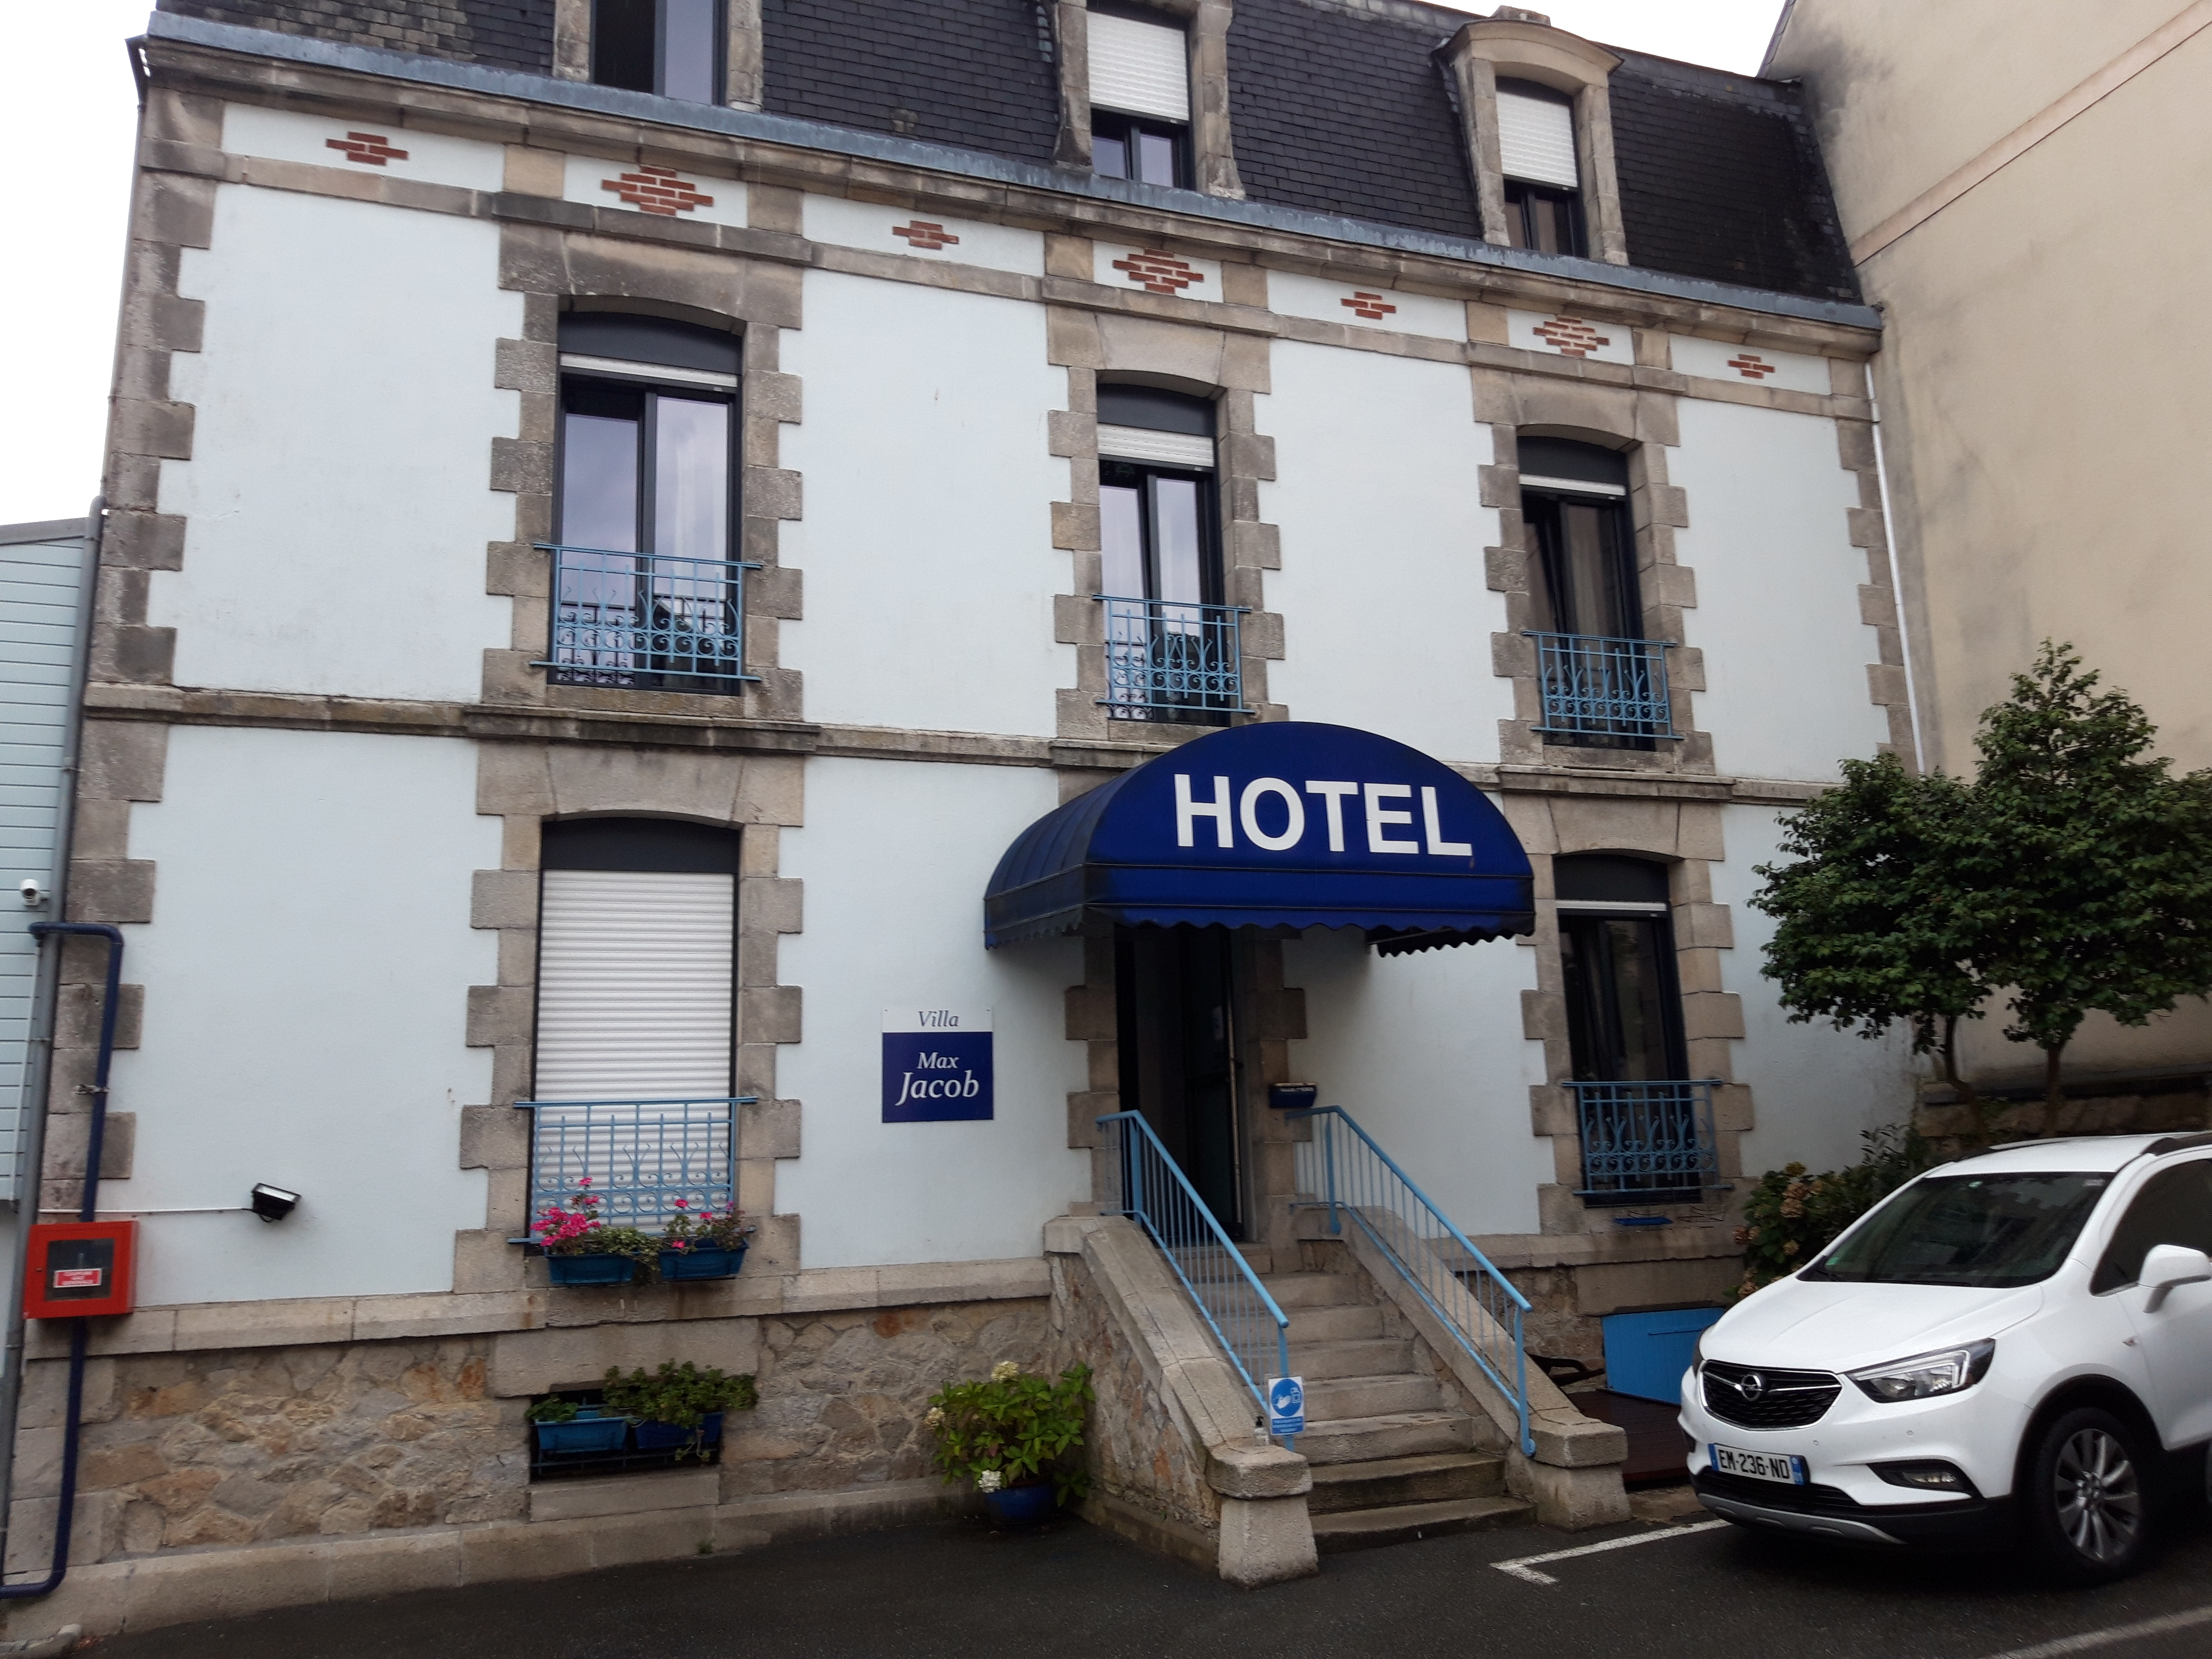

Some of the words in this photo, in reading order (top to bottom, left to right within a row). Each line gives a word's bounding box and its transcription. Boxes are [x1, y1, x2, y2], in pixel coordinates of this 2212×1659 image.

[1174, 773, 1473, 856] HOTEL
[918, 1010, 960, 1027] Villa
[916, 1051, 960, 1069] Max
[894, 1069, 980, 1106] Jacob
[1718, 1449, 1790, 1479] EM-236-ND
